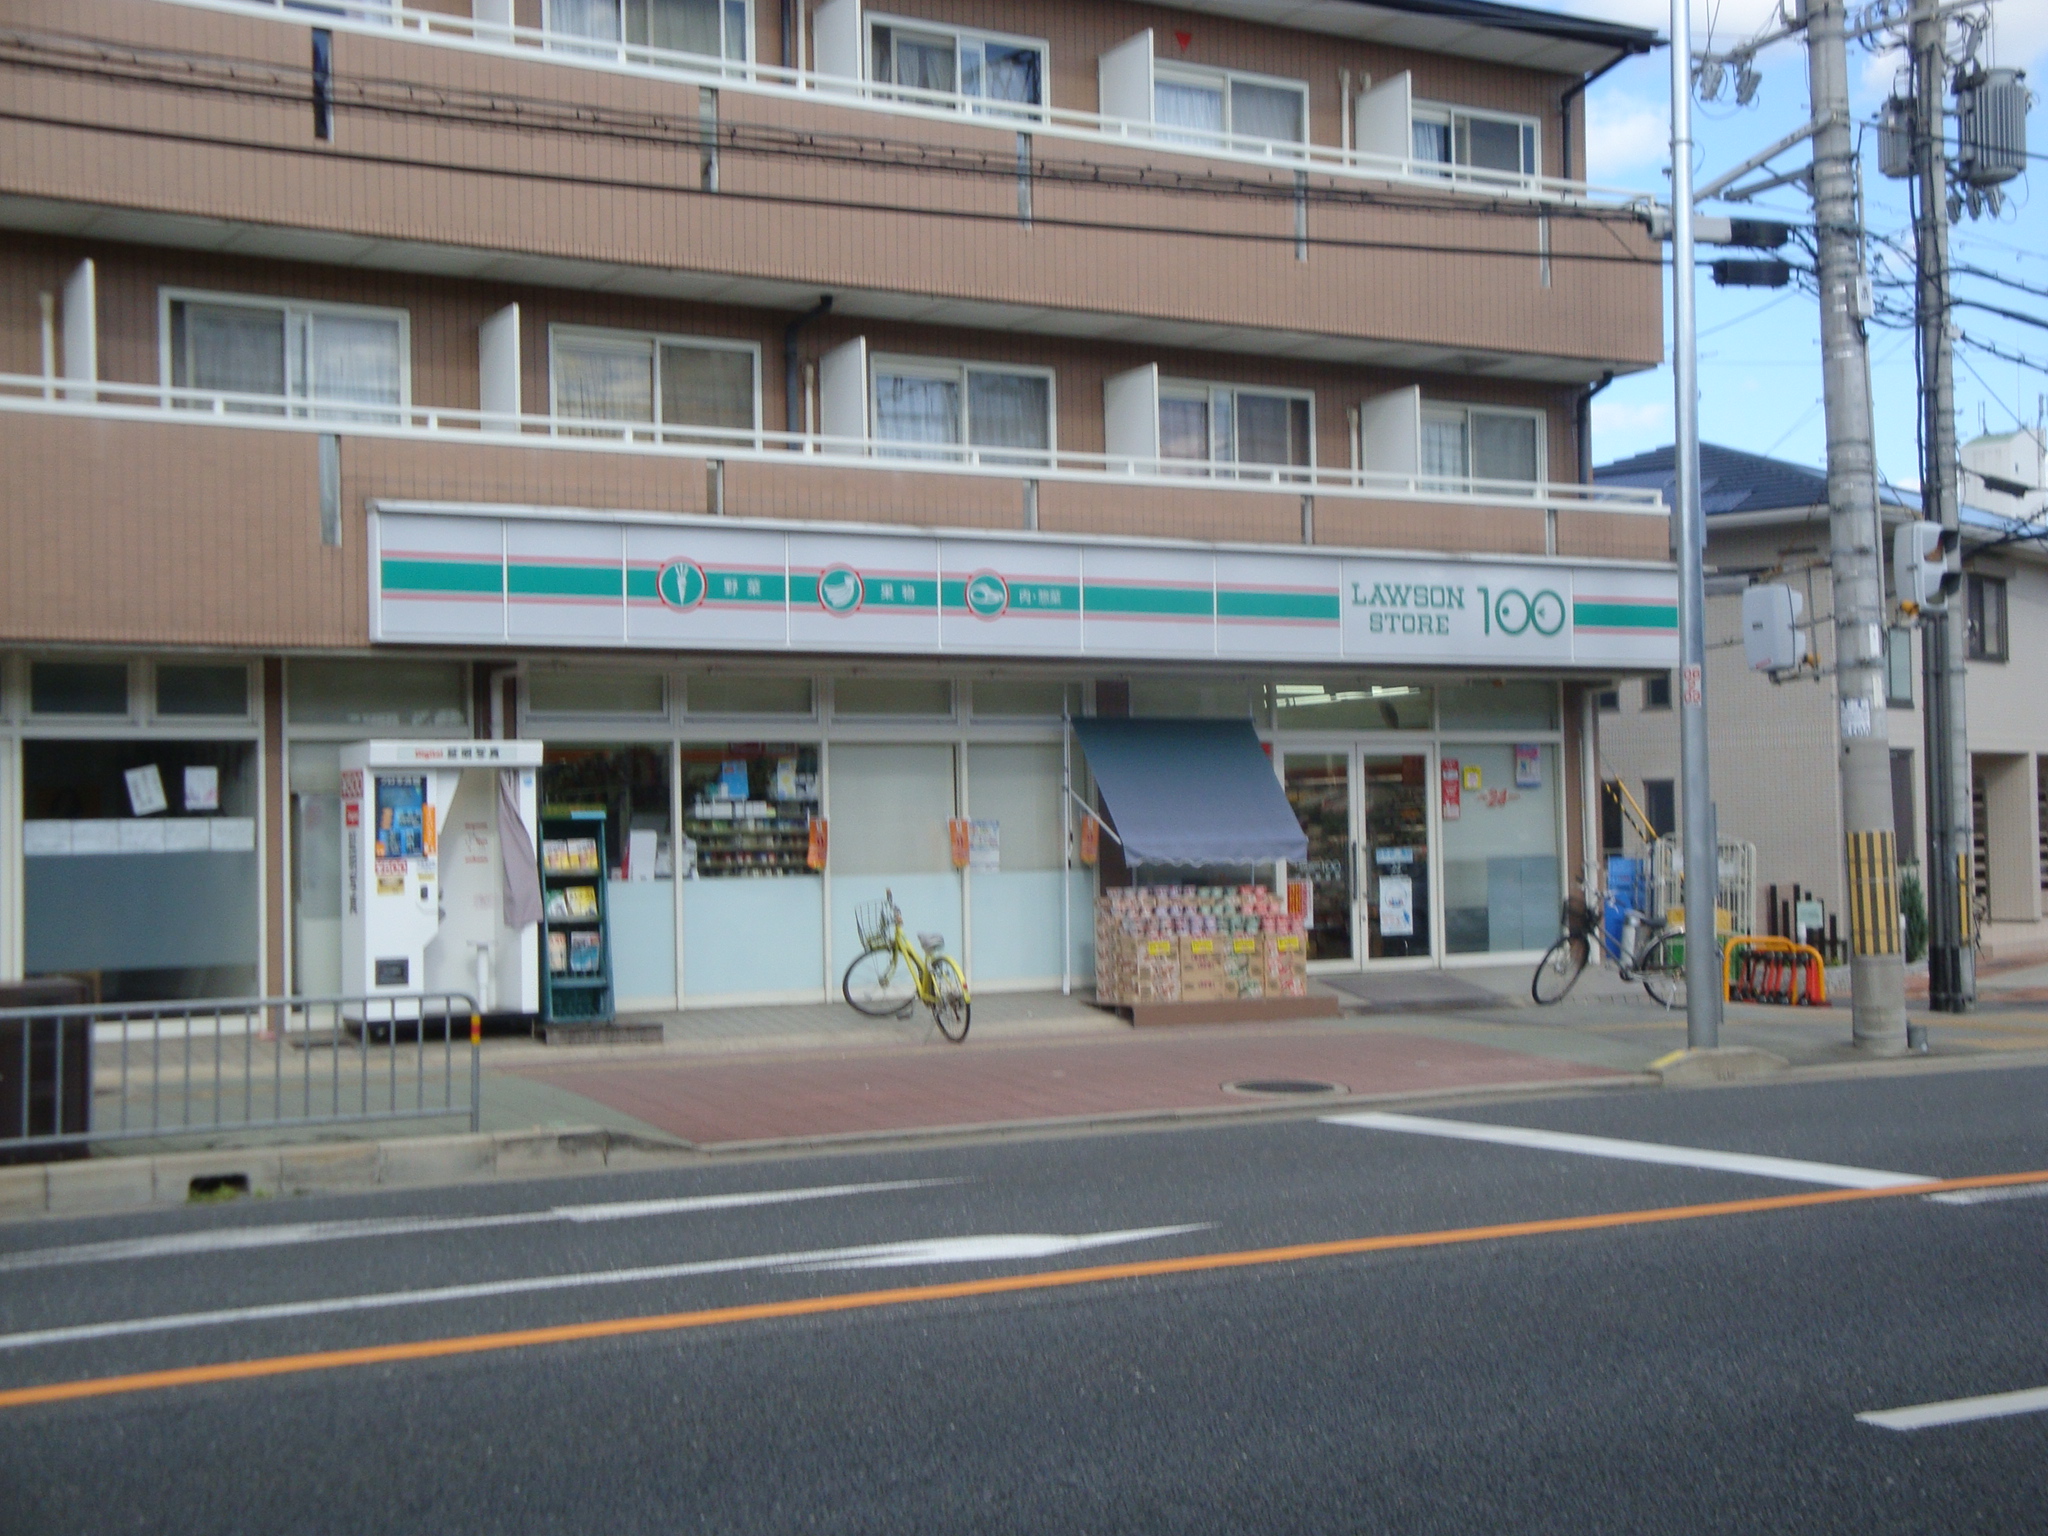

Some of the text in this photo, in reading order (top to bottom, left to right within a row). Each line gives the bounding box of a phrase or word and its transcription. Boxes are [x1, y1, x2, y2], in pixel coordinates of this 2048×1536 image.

[1351, 583, 1465, 610] LAWSON
[1370, 612, 1449, 635] STORE
[1477, 586, 1566, 636] 100
